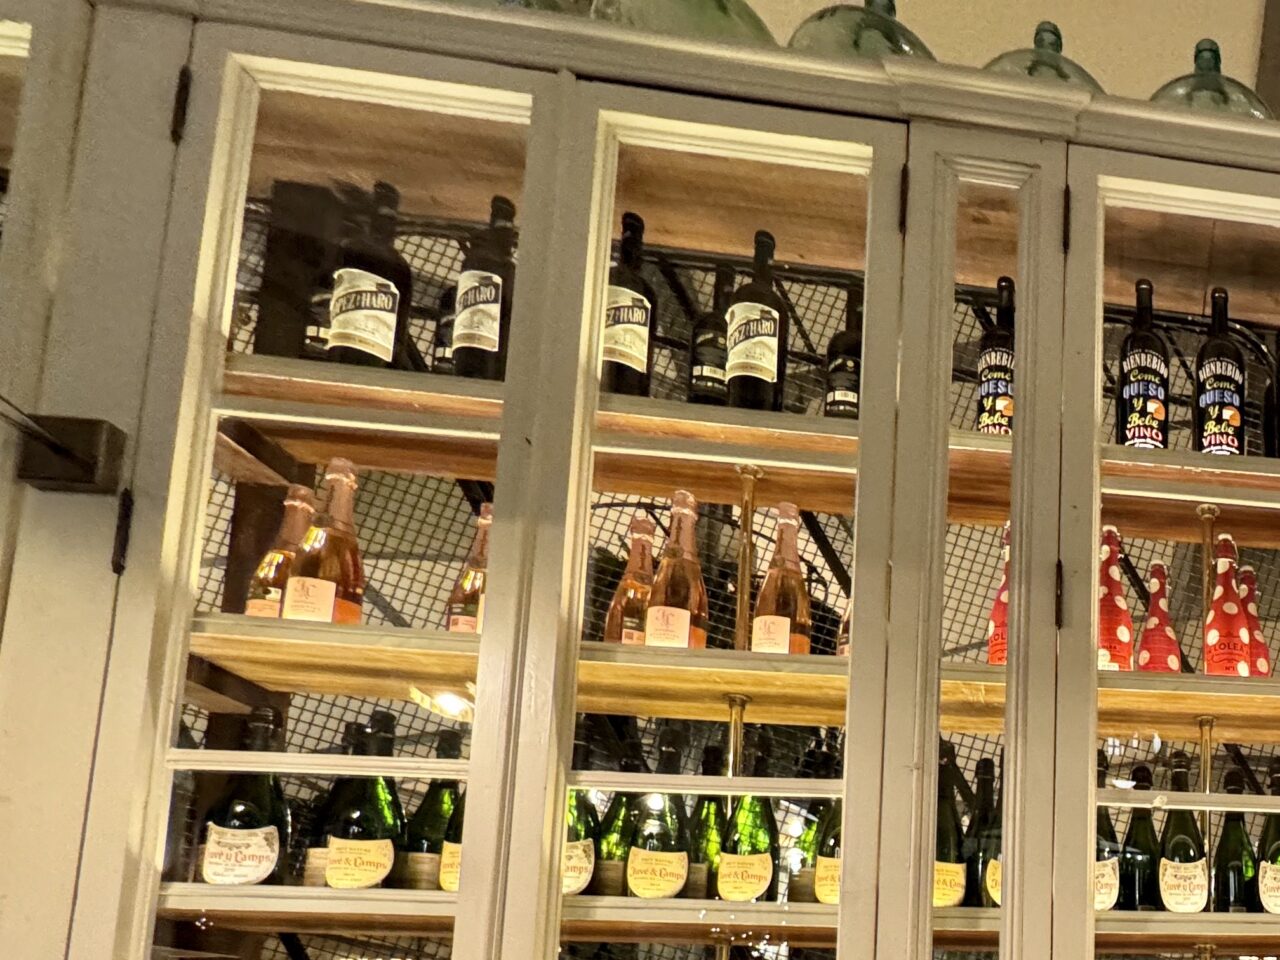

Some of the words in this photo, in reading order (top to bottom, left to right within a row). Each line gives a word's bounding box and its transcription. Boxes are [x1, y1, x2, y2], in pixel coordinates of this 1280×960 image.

[361, 292, 393, 310] HARO
[620, 307, 646, 324] HARO
[750, 319, 774, 336] HARO
[1123, 353, 1168, 379] BIENBEBIDO
[1199, 360, 1243, 385] BIENBEBIDO
[982, 368, 1012, 381] Come
[1130, 369, 1161, 384] Come
[1123, 381, 1165, 400] QUESO
[1206, 378, 1235, 391] Come
[1199, 389, 1240, 408] QUESO
[979, 412, 1009, 429] Bebe
[1126, 413, 1159, 429] Bebe
[1126, 427, 1163, 441] VINO
[1204, 421, 1234, 437] Bebe
[1202, 434, 1239, 447] VINO
[1214, 641, 1245, 652] LOLEA
[565, 863, 588, 876] amps
[659, 867, 685, 880] Camps
[741, 870, 768, 882] Camps
